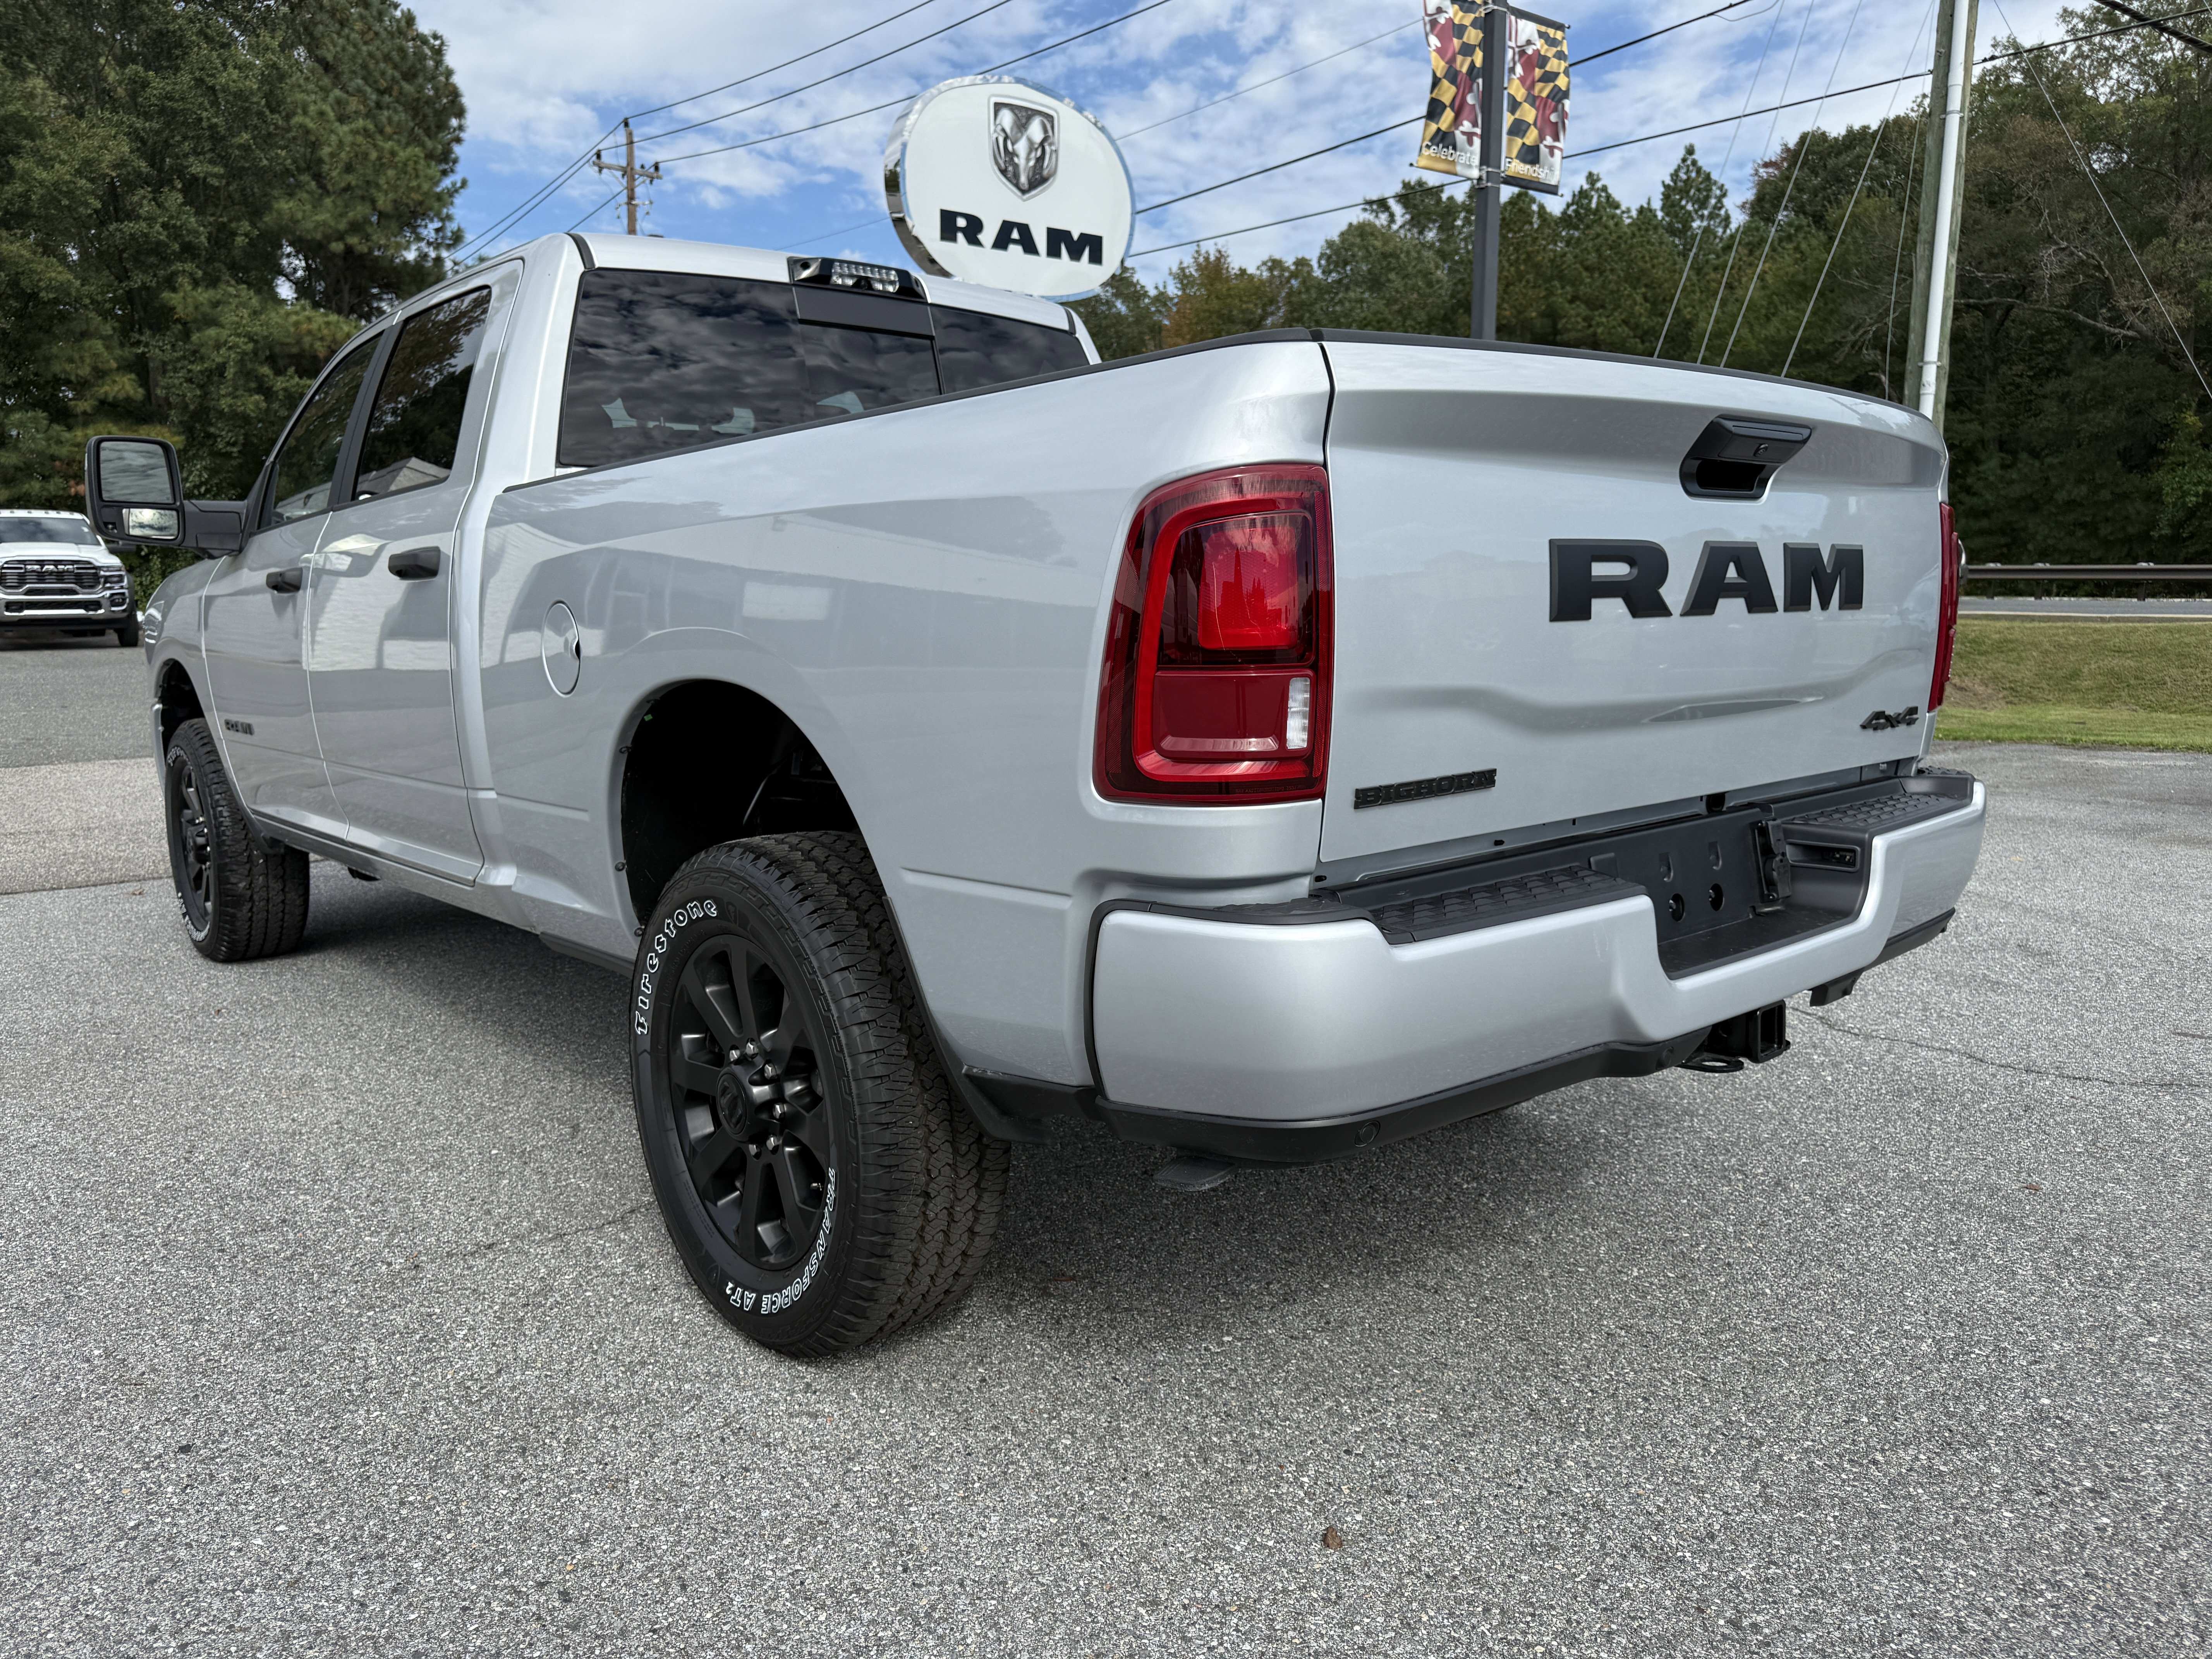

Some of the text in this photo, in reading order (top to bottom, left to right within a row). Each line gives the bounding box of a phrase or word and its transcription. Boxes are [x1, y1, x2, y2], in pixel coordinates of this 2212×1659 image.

[1422, 142, 1477, 166] Celebrate
[940, 209, 1103, 266] RAM
[1549, 538, 1863, 622] RAM
[635, 900, 717, 1035] Firestone
[761, 1167, 836, 1314] TRANSFORCE
